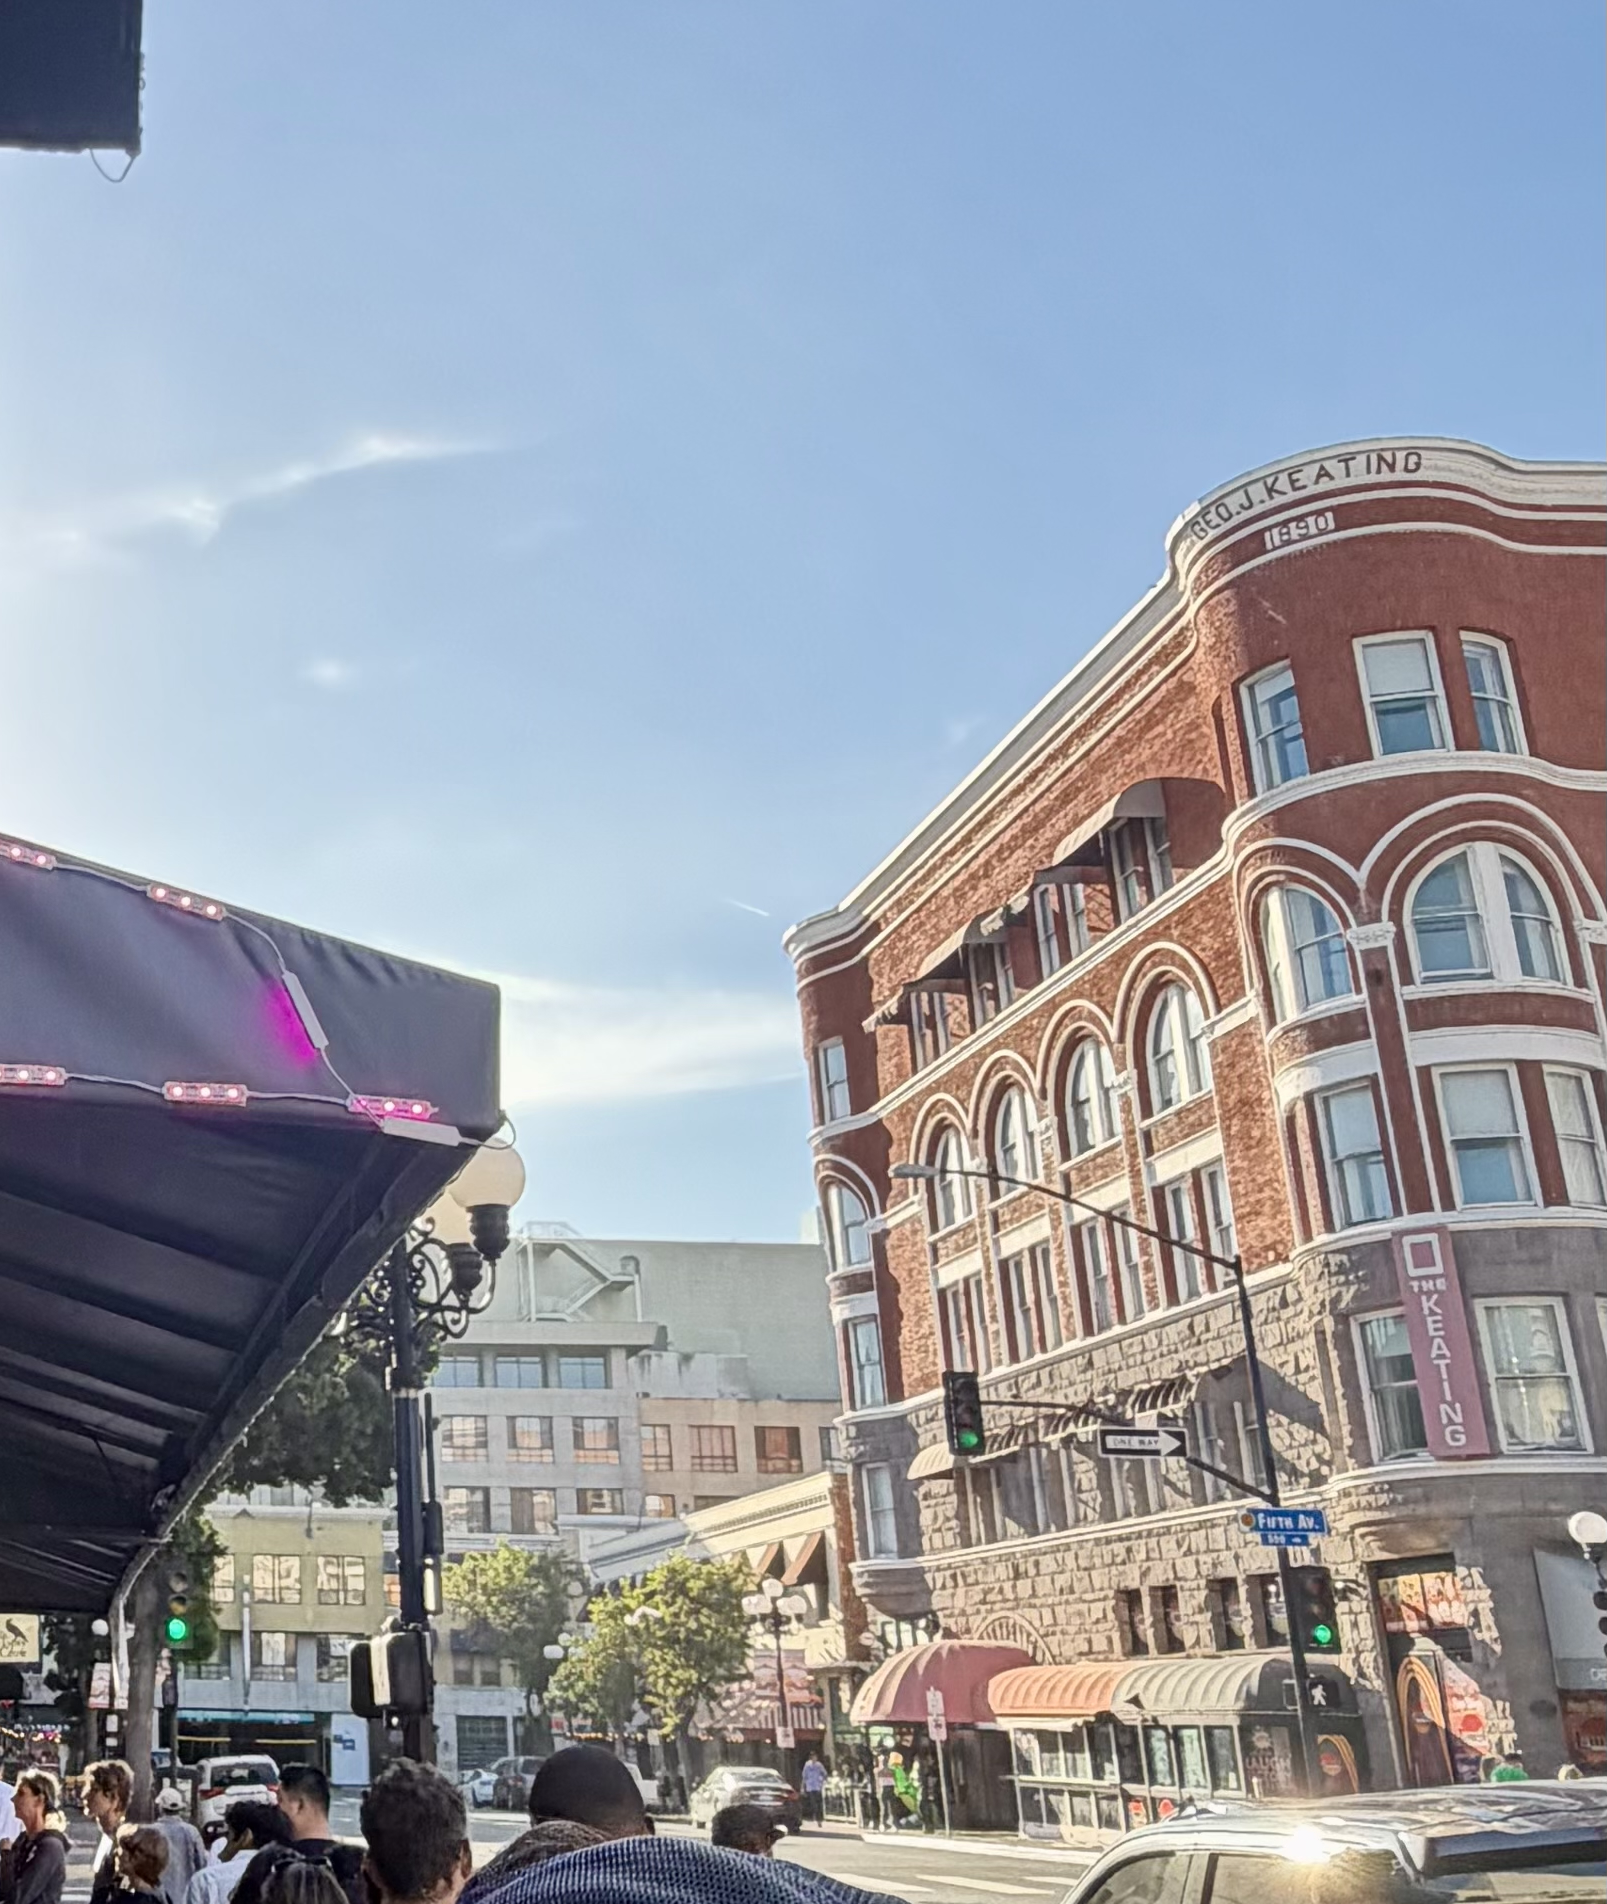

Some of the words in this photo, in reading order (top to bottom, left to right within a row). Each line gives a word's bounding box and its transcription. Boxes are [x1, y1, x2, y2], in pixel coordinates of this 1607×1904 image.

[1263, 450, 1423, 502] KEATING
[1268, 514, 1330, 548] 1890
[1408, 1279, 1447, 1294] THE
[1420, 1293, 1467, 1448] KEATING
[1138, 1439, 1160, 1447] WAY
